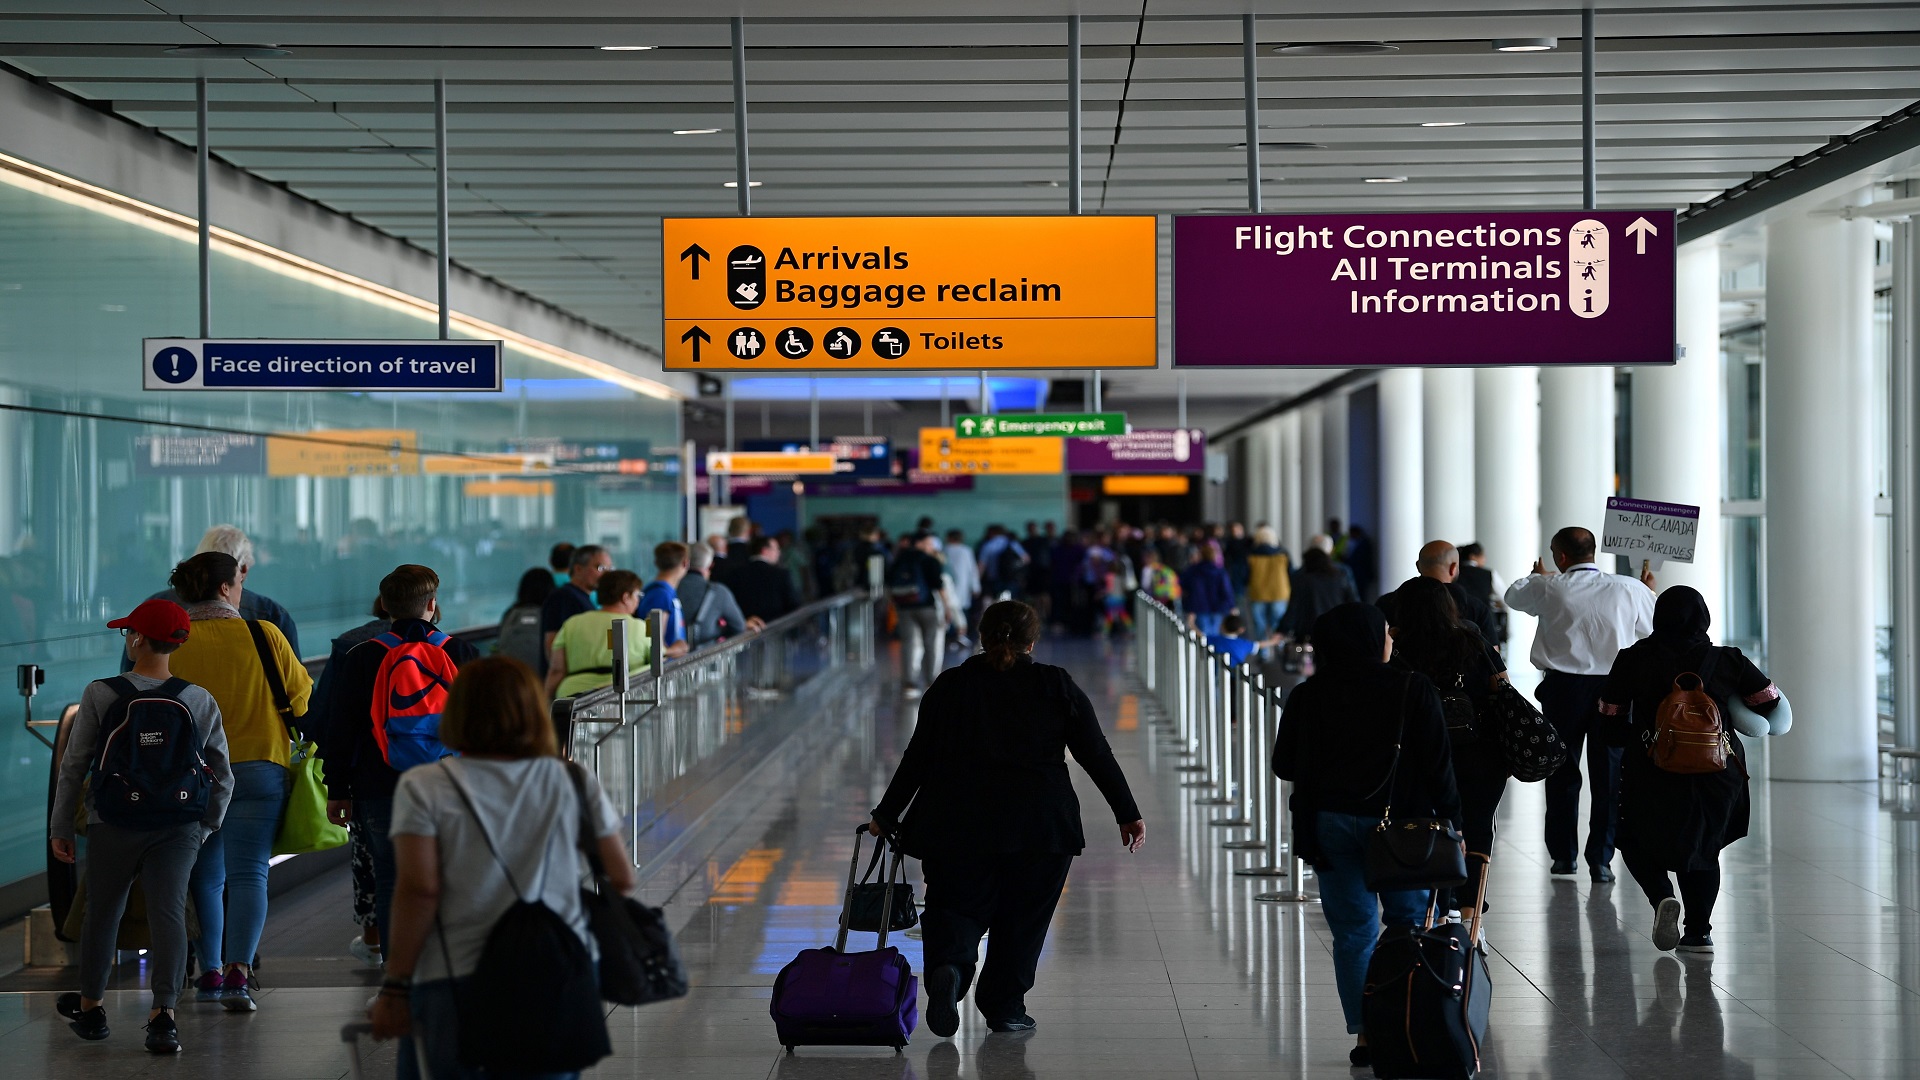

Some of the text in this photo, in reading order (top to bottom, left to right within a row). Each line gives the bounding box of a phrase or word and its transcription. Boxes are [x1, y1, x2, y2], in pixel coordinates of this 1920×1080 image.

[1235, 222, 1562, 256] Flight Connections
[773, 245, 910, 271] Arrivals
[1330, 254, 1562, 282] All Terminals
[775, 277, 1062, 309] Baggage reclaim
[1350, 287, 1562, 314] Information
[919, 331, 1004, 350] Toilets
[210, 355, 476, 374] Face direction of travel
[997, 418, 1107, 433] Emergency exit
[1619, 501, 1697, 515] Connecting passengers
[1618, 514, 1631, 523] To:
[1603, 535, 1646, 549] UNITED
[1646, 541, 1694, 560] AIRLINES
[130, 791, 140, 801] S
[180, 791, 188, 800] D
